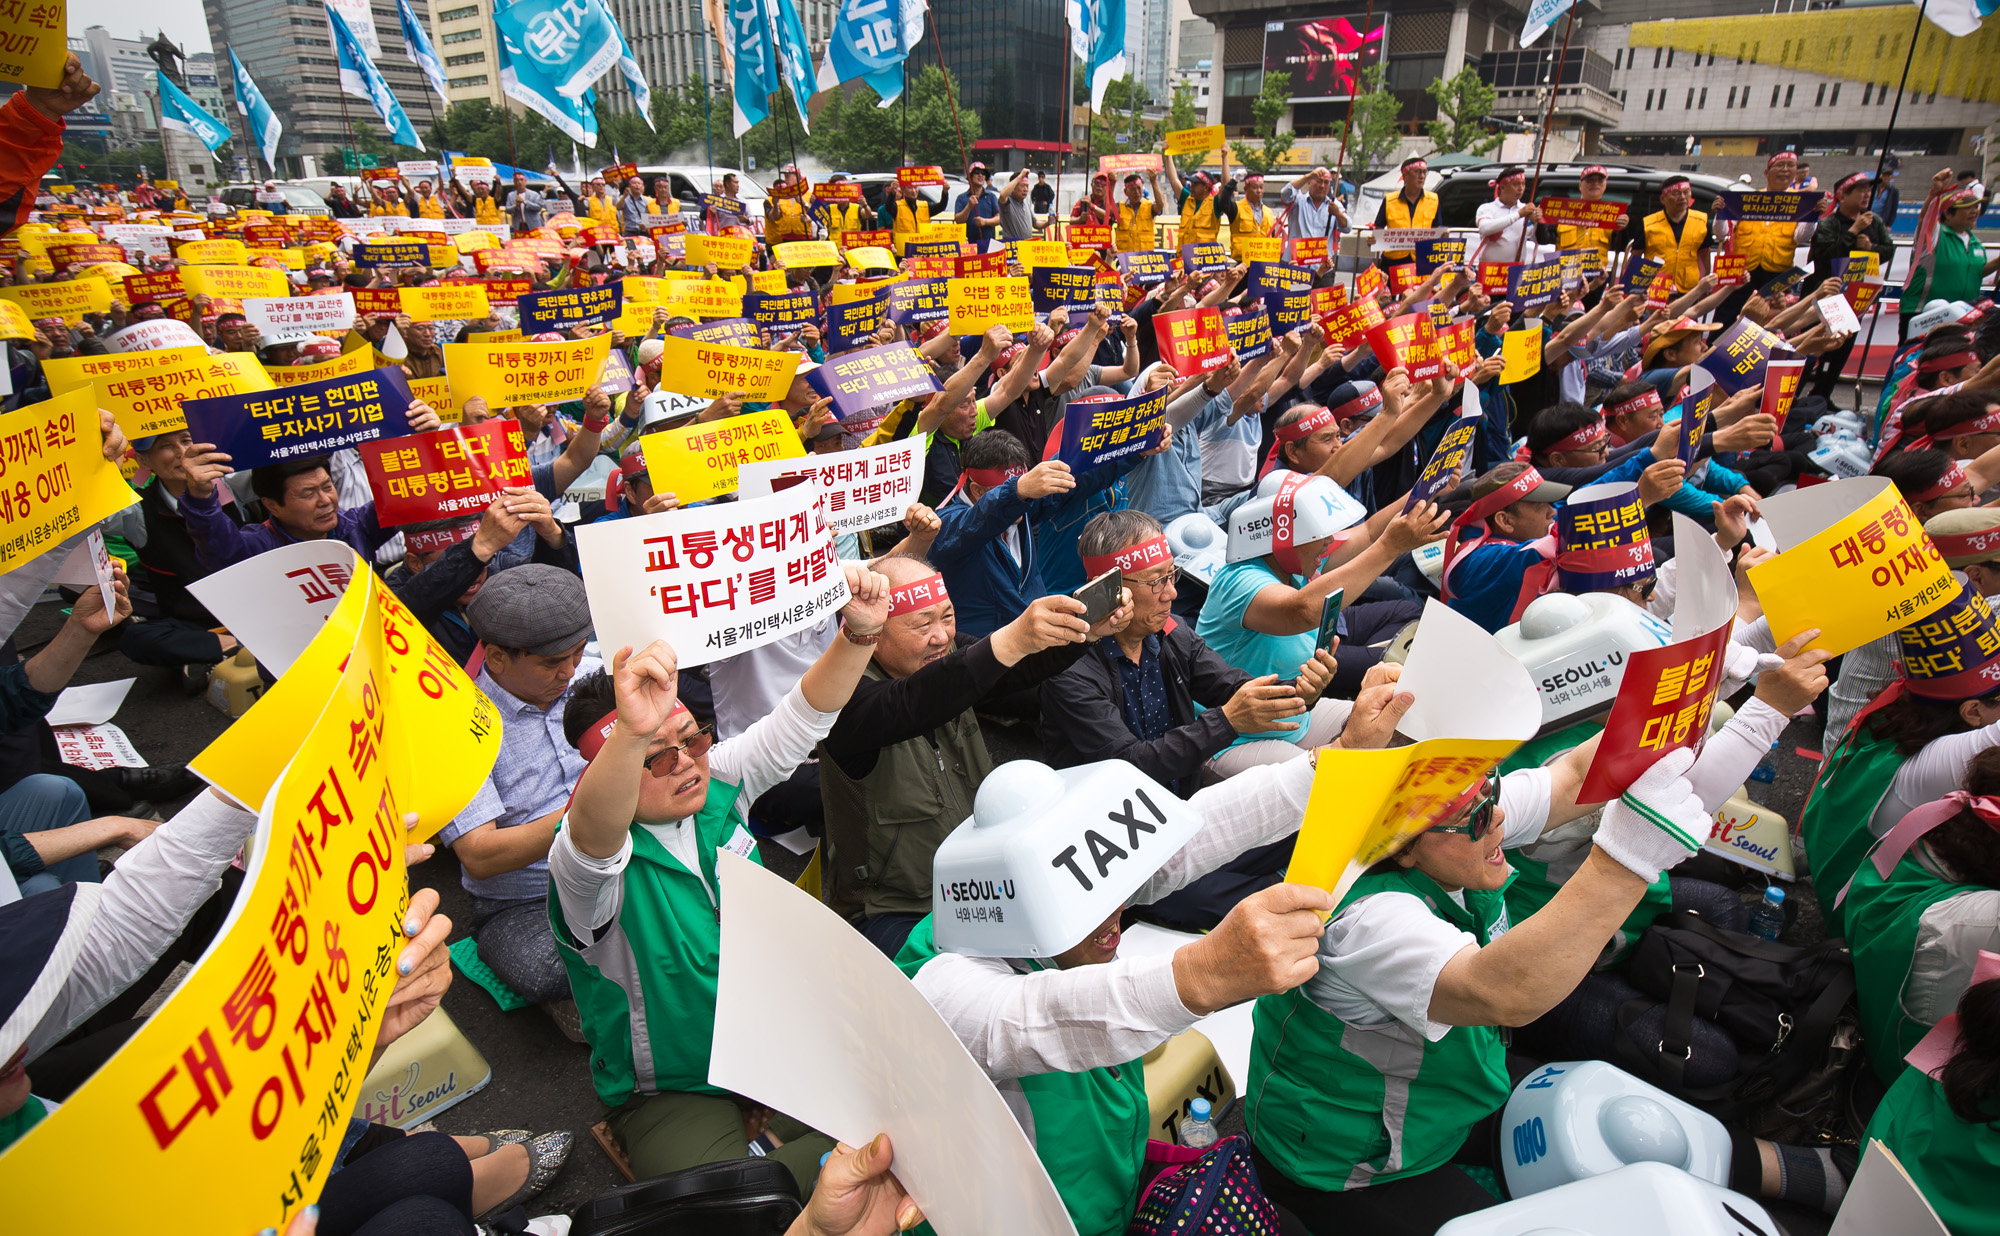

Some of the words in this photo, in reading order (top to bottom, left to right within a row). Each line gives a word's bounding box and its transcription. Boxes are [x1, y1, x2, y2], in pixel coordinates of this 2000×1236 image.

[29, 5, 61, 29] 속인
[1741, 194, 1770, 203] '타다'는
[1774, 195, 1801, 204] 현대판
[1742, 205, 1777, 213] 투자사기
[1780, 205, 1797, 213] 기업
[1050, 273, 1092, 287] 국민분열
[1259, 277, 1278, 287] '타다'
[1265, 266, 1291, 279] 국민분열
[422, 291, 462, 300] 대통령까지
[464, 290, 478, 298] 속인
[537, 294, 579, 309] 국민분열
[580, 288, 612, 302] 공유경제
[687, 285, 711, 294] 이재용
[894, 285, 930, 298] 국민분열
[964, 286, 989, 299] 악법
[995, 286, 1006, 298] 중
[1010, 284, 1026, 298] 악법
[1044, 288, 1069, 301] '타다'
[1073, 290, 1089, 301] 퇴출
[265, 302, 314, 313] 교통생태계
[318, 299, 343, 308] 교란종
[430, 301, 453, 310] 이재용
[456, 300, 472, 309] OUT!
[532, 308, 558, 321] '타다'
[562, 307, 583, 318] 퇴출
[760, 299, 790, 310] 국민분열
[892, 298, 914, 311] '타다'
[918, 297, 934, 309] 퇴출
[955, 306, 989, 318] 승차난
[267, 313, 302, 323] '타다'를
[305, 310, 344, 320] 박멸하라!
[754, 312, 775, 322] '타다'
[778, 311, 793, 321] 퇴출
[1228, 319, 1256, 334] 국민분열
[1275, 310, 1300, 322] '타다'
[1325, 316, 1349, 332] 높은
[692, 324, 734, 341] 국민분열
[839, 322, 857, 336] '타다'
[859, 320, 873, 331] 퇴출
[1171, 318, 1196, 337] 불법
[1386, 322, 1416, 345] 불법
[1174, 340, 1215, 358] 대통령님,
[1244, 336, 1254, 348] 퇴출
[81, 359, 154, 374] 대통령까지
[338, 358, 357, 373] 속인
[488, 350, 567, 369] 대통령까지
[572, 346, 594, 362] 속인
[697, 349, 762, 371] 대통령까지
[764, 359, 784, 372] 속인
[834, 354, 886, 377] 국민분열
[884, 347, 924, 365] 공유경제
[1732, 347, 1764, 375] '타다'
[108, 368, 206, 400] 대통령까지
[209, 361, 241, 378] 속인
[504, 371, 550, 388] 이재용
[555, 367, 585, 383] OUT!
[707, 369, 748, 387] 이재용
[750, 375, 772, 387] OUT!
[836, 378, 871, 394] '타다'
[872, 370, 899, 386] 퇴출
[243, 393, 320, 420] '타다'는
[324, 380, 380, 404] 현대판
[504, 386, 585, 402] 서울개인택시운송사업조합
[1614, 390, 1649, 415] 정치적
[261, 407, 342, 442] 투자사기
[347, 403, 384, 426] 기업
[1091, 408, 1134, 430] 국민분열
[1136, 394, 1166, 419] 공유경제
[44, 412, 76, 449] 속인
[687, 423, 759, 453] 대통령까지
[762, 418, 784, 434] 속인
[1080, 432, 1108, 453] '타다'
[1109, 427, 1130, 446] 퇴출
[269, 428, 380, 459] 서울개인택시운송사업조합
[380, 447, 422, 473] 불법
[435, 434, 492, 460] '타다'
[706, 447, 749, 472] 이재용
[753, 442, 781, 461] OUT!
[874, 450, 911, 475] 교란종
[37, 462, 72, 503] OUT!
[387, 467, 482, 500] 대통령님,
[852, 476, 911, 505] 박멸하라!
[643, 511, 811, 573] 교통생태계
[1114, 539, 1162, 572] 정치적
[650, 570, 777, 619] '타다'를
[705, 579, 846, 650] 서울개인택시운송사업조합
[1651, 649, 1716, 707] 불법
[1549, 691, 1570, 706] 너와
[1571, 684, 1590, 699] 나의
[1591, 676, 1613, 692] 서울
[1051, 788, 1167, 892] TAXI
[955, 906, 970, 922] 너와
[971, 906, 988, 922] 나의
[989, 906, 1004, 923] 서울
[136, 764, 354, 1152] 대통령까지
[250, 920, 352, 1142] 이재용
